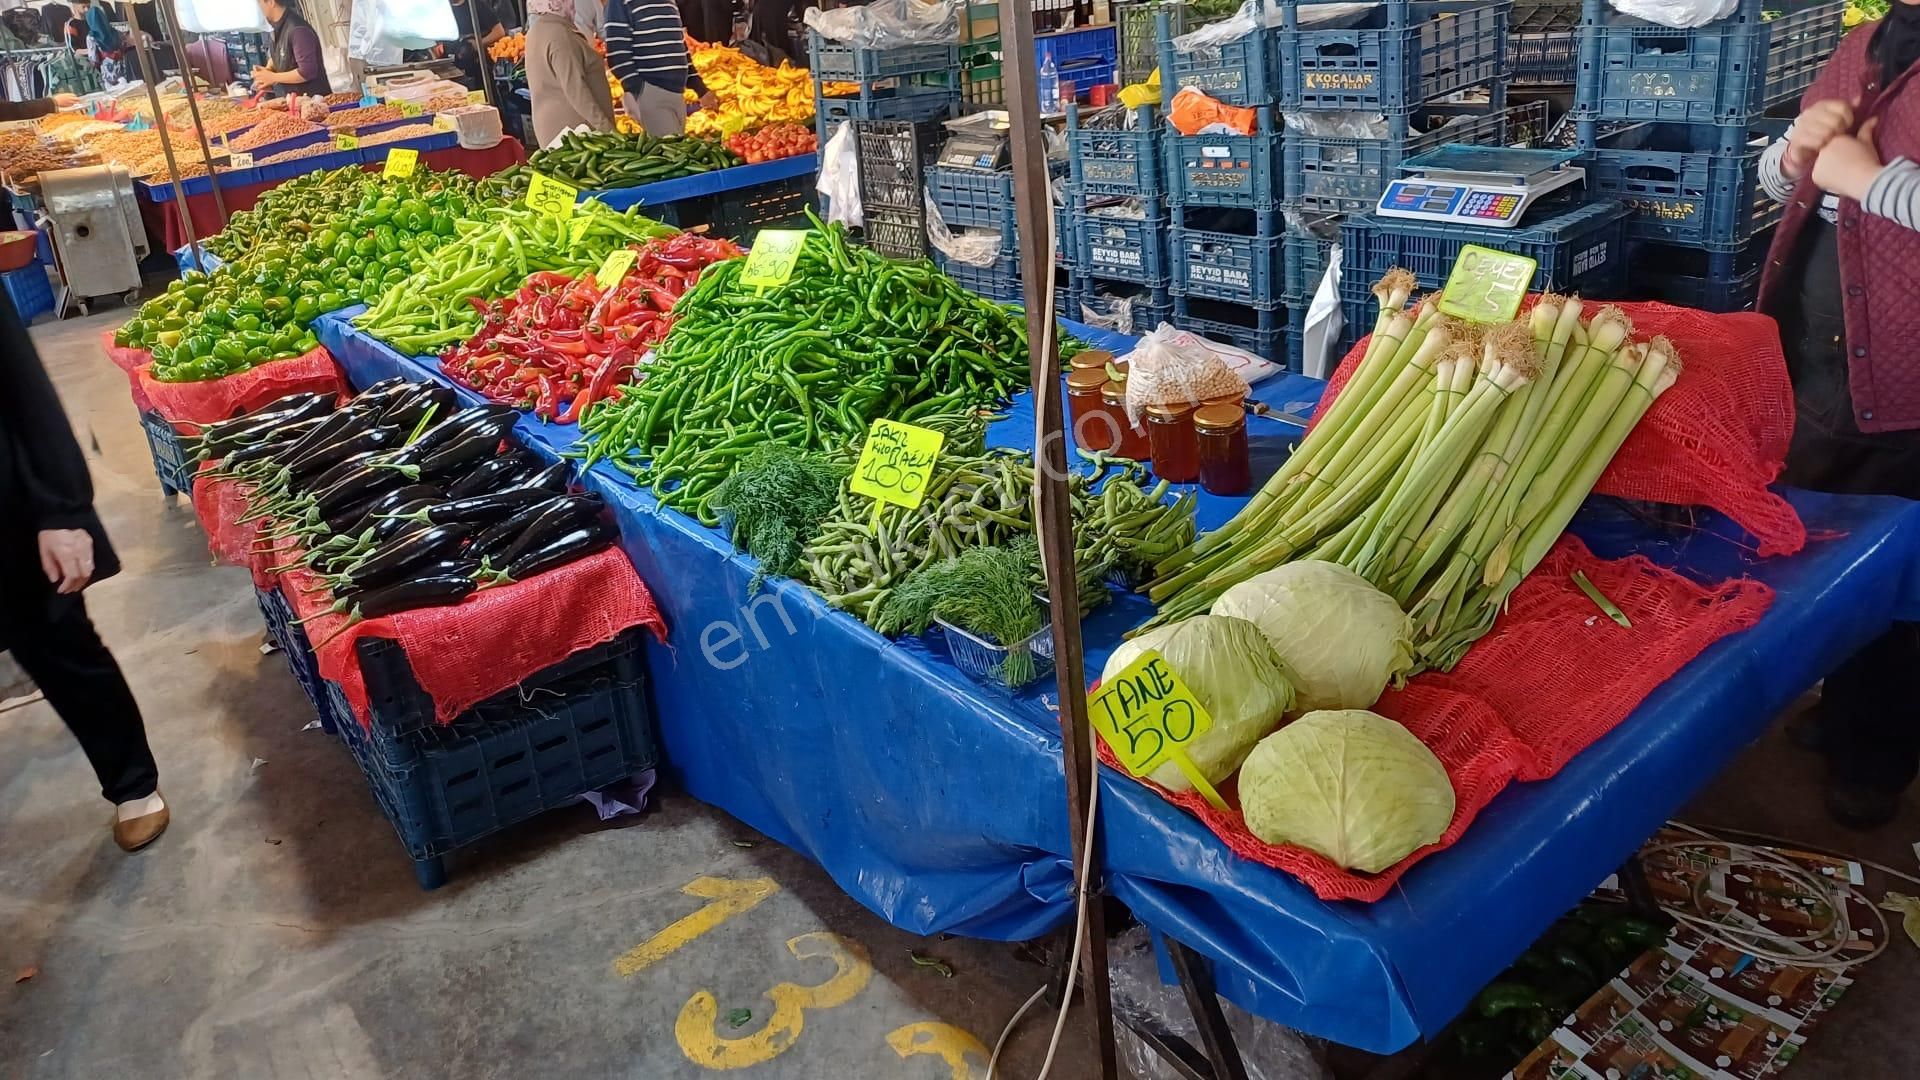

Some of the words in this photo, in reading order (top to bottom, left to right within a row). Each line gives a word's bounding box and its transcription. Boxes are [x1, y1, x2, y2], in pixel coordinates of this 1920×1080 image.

[1315, 73, 1373, 84] KOCALAR
[1223, 269, 1249, 281] BABA
[862, 458, 923, 494] 100
[1093, 658, 1175, 734] TANE
[1122, 698, 1195, 769] 50
